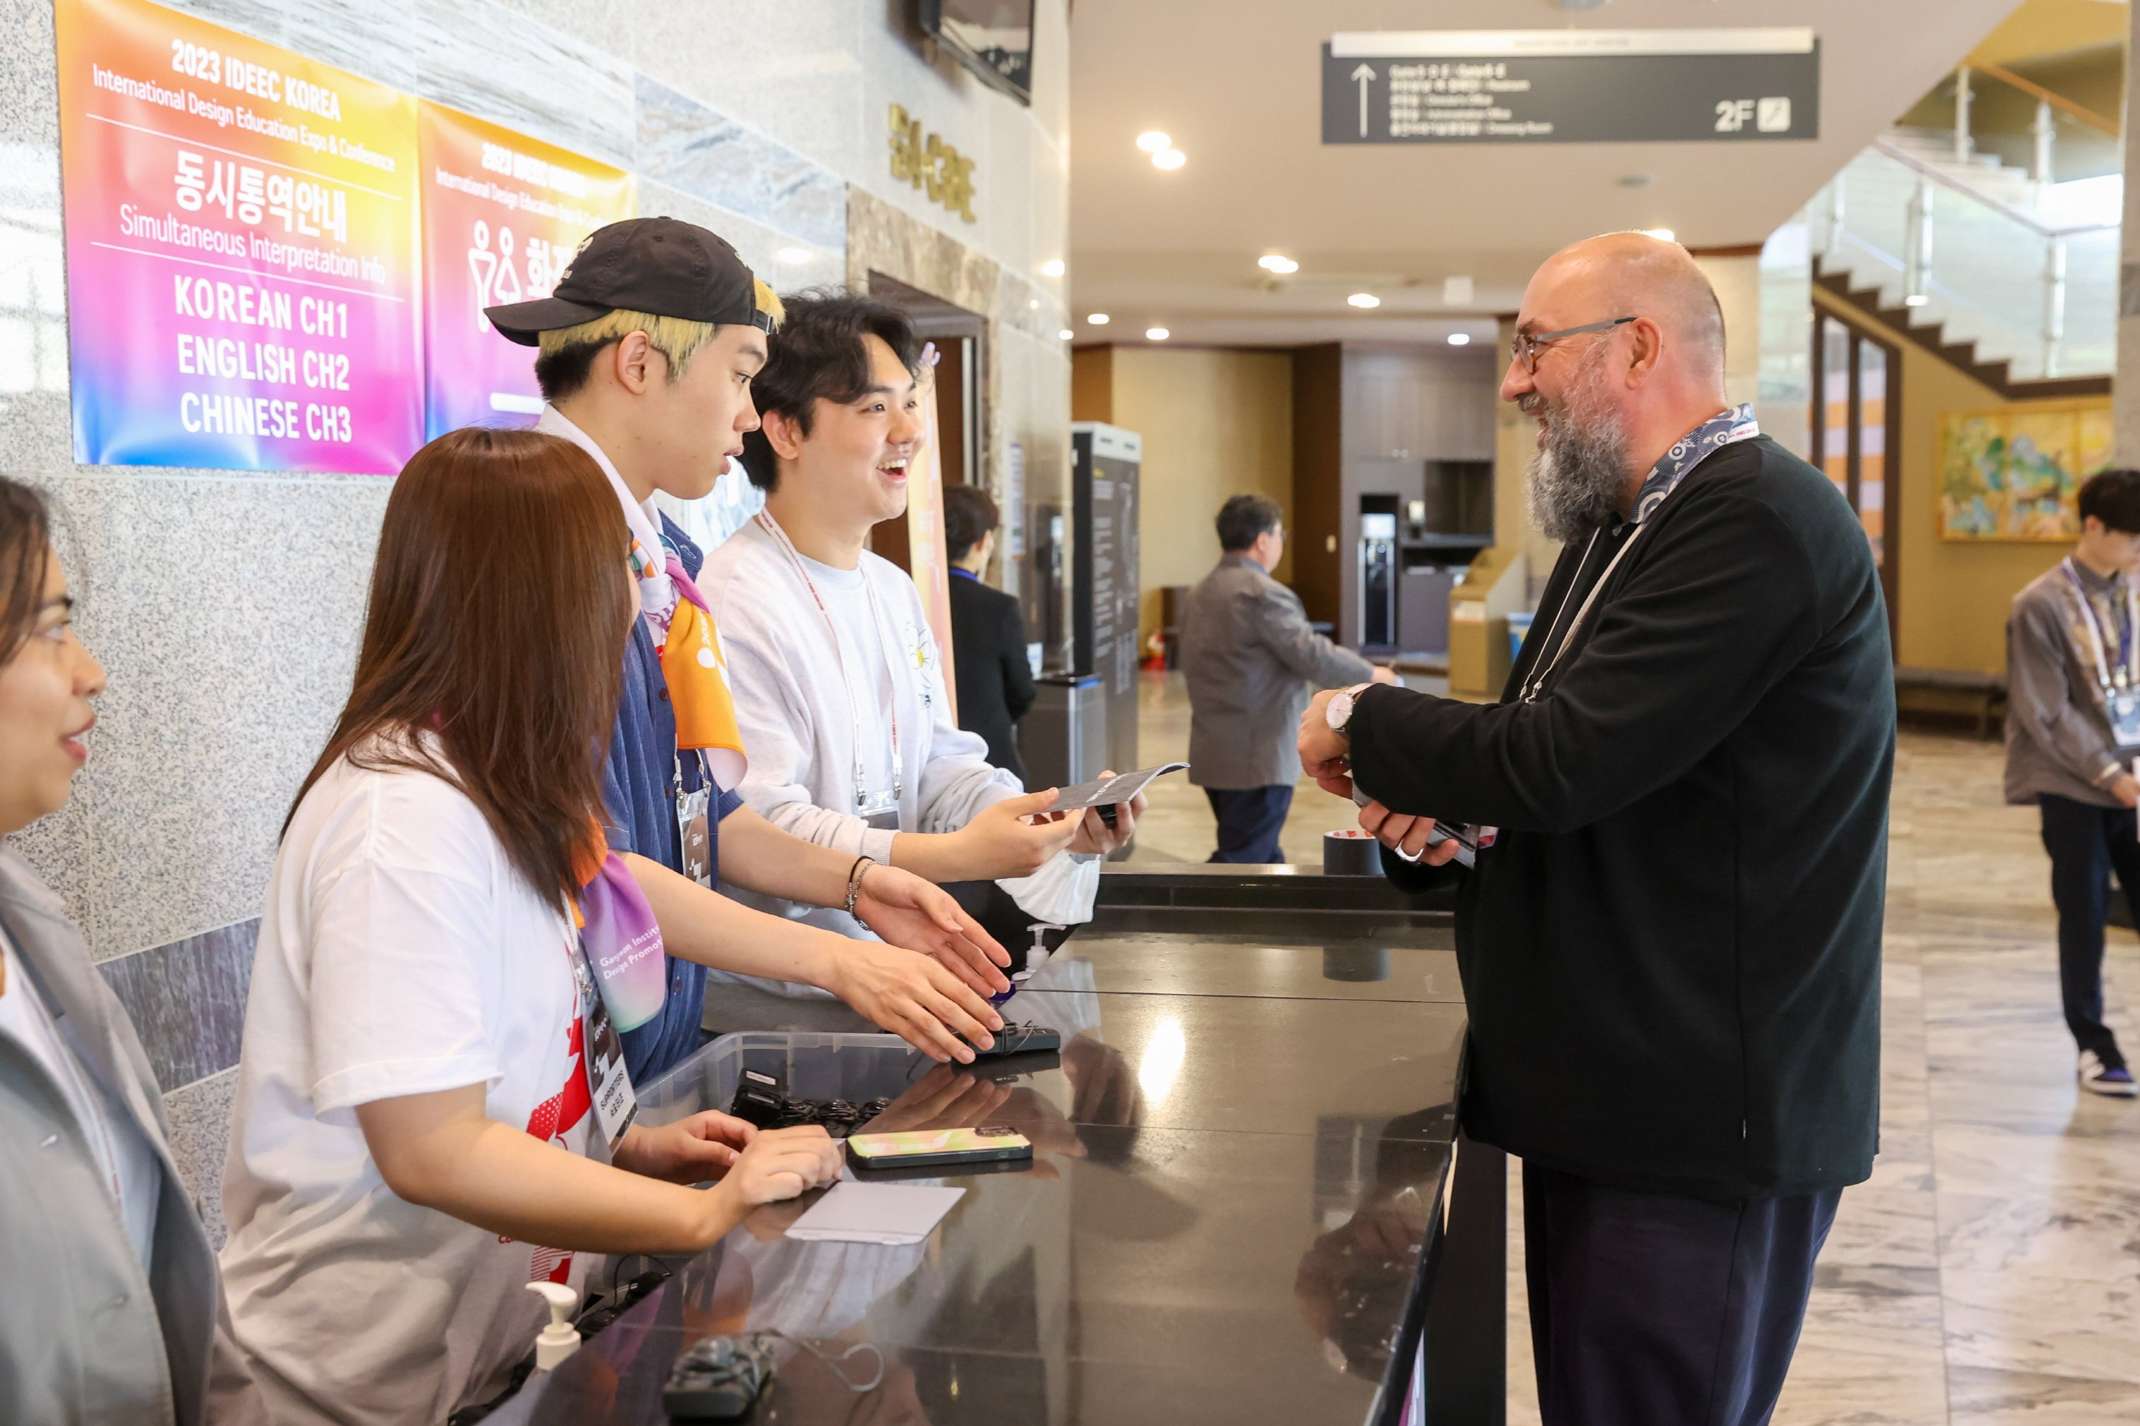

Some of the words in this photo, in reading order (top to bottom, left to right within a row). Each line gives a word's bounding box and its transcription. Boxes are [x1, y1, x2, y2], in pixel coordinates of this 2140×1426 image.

[92, 63, 186, 111] International
[188, 91, 234, 128] Design
[236, 105, 298, 144] Education
[171, 38, 221, 84] 2023
[225, 56, 281, 102] IDEEC
[285, 76, 342, 122] KOREA
[1714, 99, 1756, 132] 2F
[174, 150, 348, 243] 동시통역안내
[120, 203, 246, 258] Simultaneous
[249, 232, 359, 278] Interpretation
[360, 254, 385, 284] Info
[174, 274, 293, 331] KOREAN
[300, 296, 348, 339] CH1
[177, 333, 297, 385] ENGLISH
[302, 349, 350, 391] CH2
[180, 392, 300, 439] CHINESE
[305, 403, 352, 443] CH3
